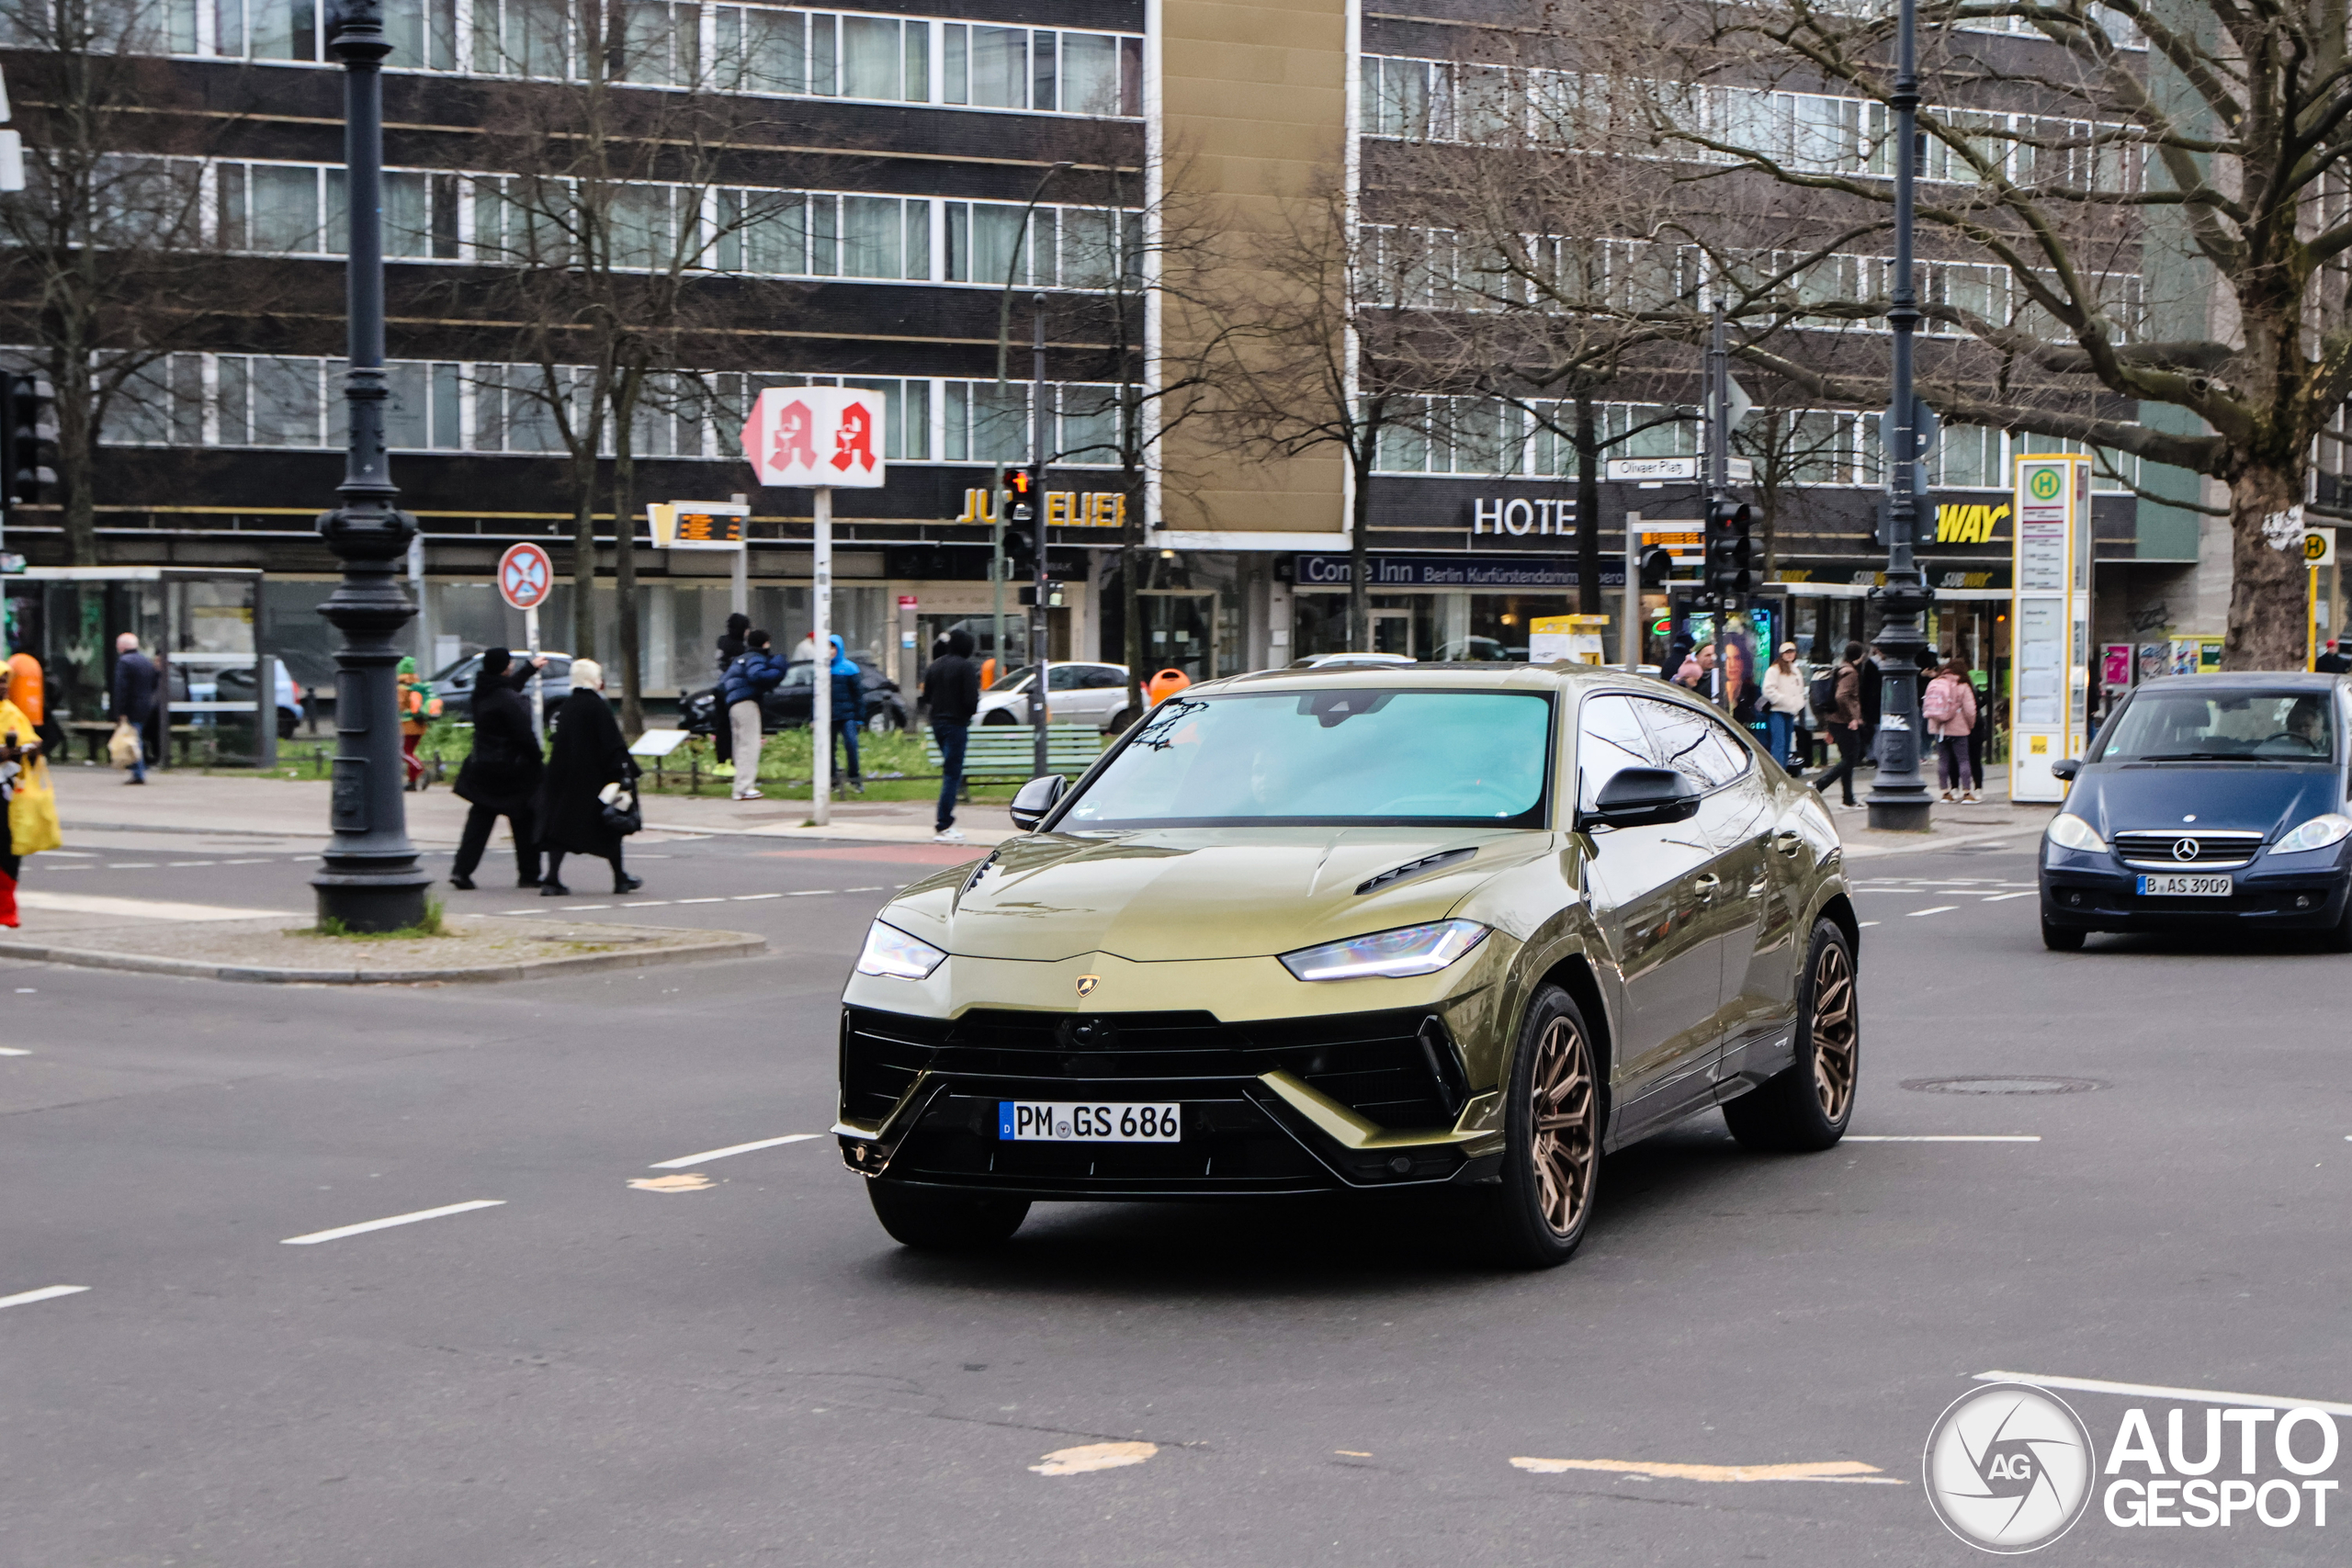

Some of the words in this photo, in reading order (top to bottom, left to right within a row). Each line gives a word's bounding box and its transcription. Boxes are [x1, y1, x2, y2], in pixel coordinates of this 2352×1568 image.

[1620, 461, 1657, 474] Olivaer
[1936, 502, 2011, 544] WAY
[1379, 558, 1414, 581] Inn
[1424, 566, 1464, 582] Berlin
[1467, 567, 1579, 584] Kurfürstendamm
[1940, 570, 1994, 589] SUBWAY
[2147, 878, 2156, 893] B
[2167, 878, 2188, 894] AS
[2190, 878, 2229, 894] 3909
[1003, 1124, 1011, 1134] D
[1016, 1106, 1053, 1136] PM
[1073, 1106, 1113, 1137] GS
[1120, 1107, 1178, 1137] 686
